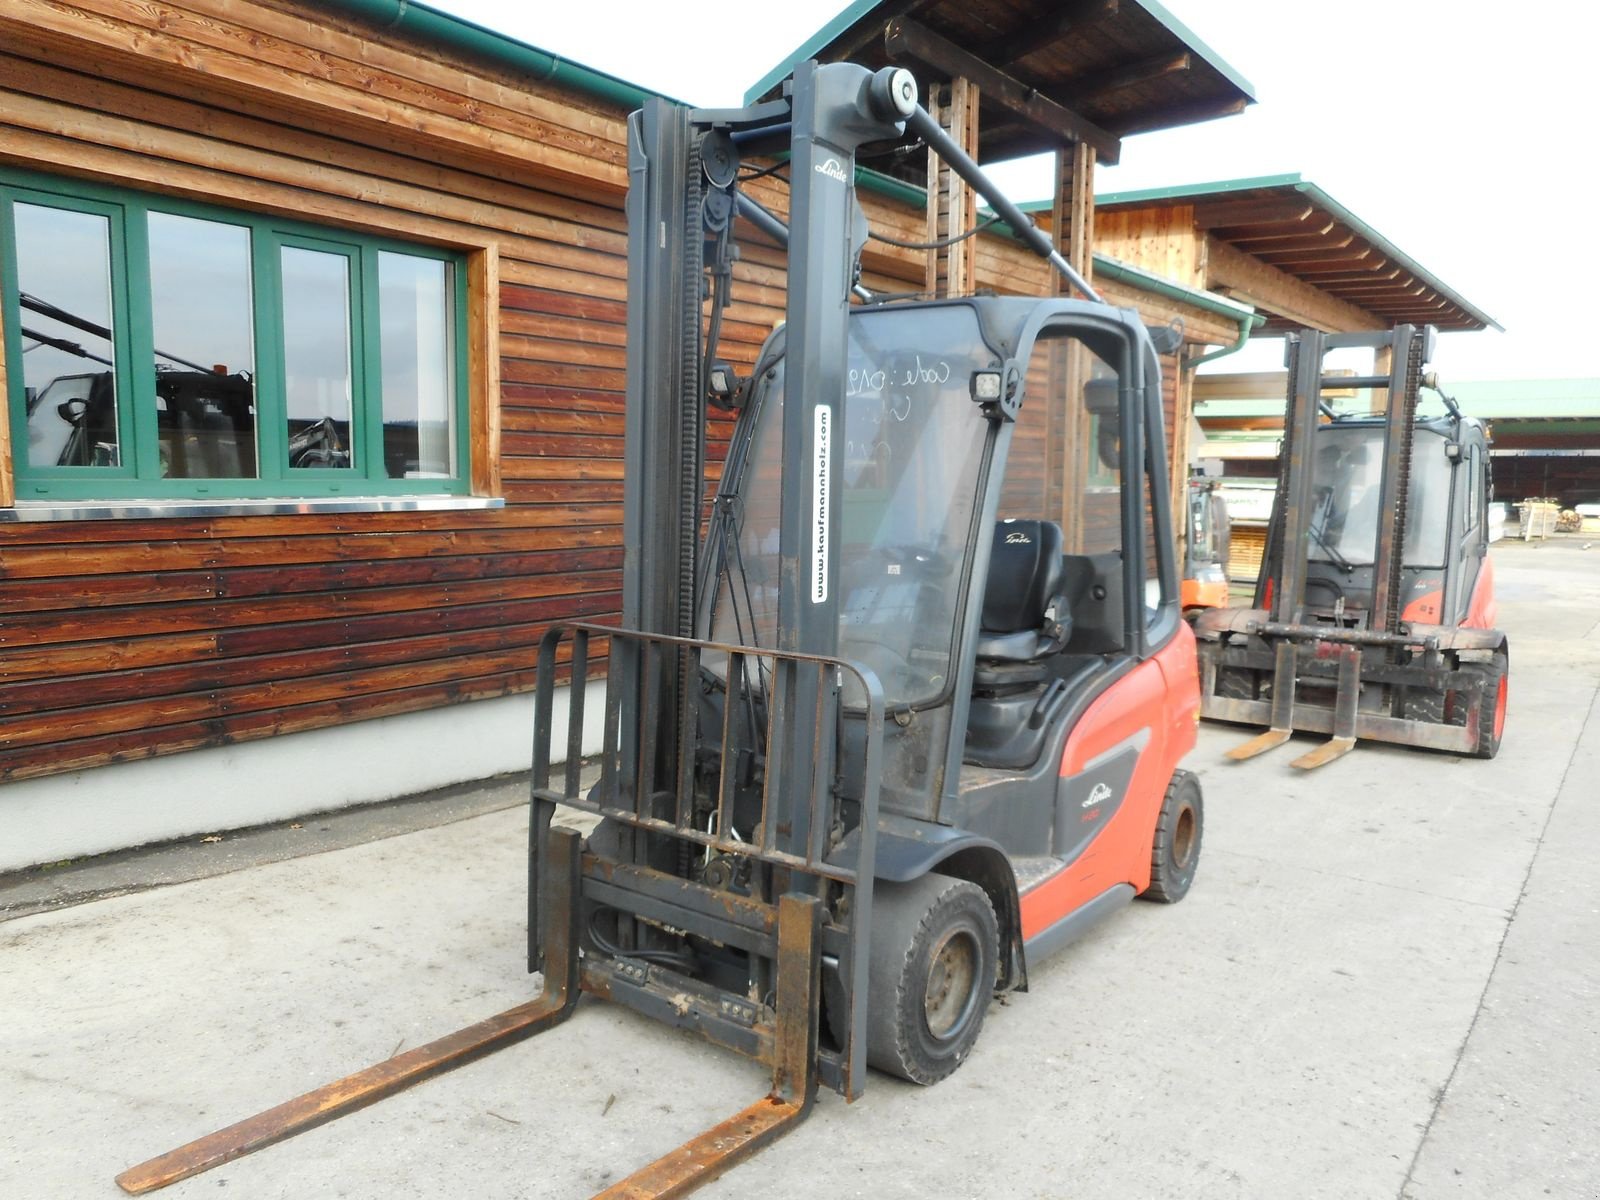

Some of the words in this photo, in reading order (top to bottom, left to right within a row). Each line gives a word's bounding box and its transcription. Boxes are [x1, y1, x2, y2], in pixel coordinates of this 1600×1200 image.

[815, 159, 847, 183] Linde
[817, 412, 827, 598] www.kaufmannholz.com
[1081, 782, 1113, 808] Linde
